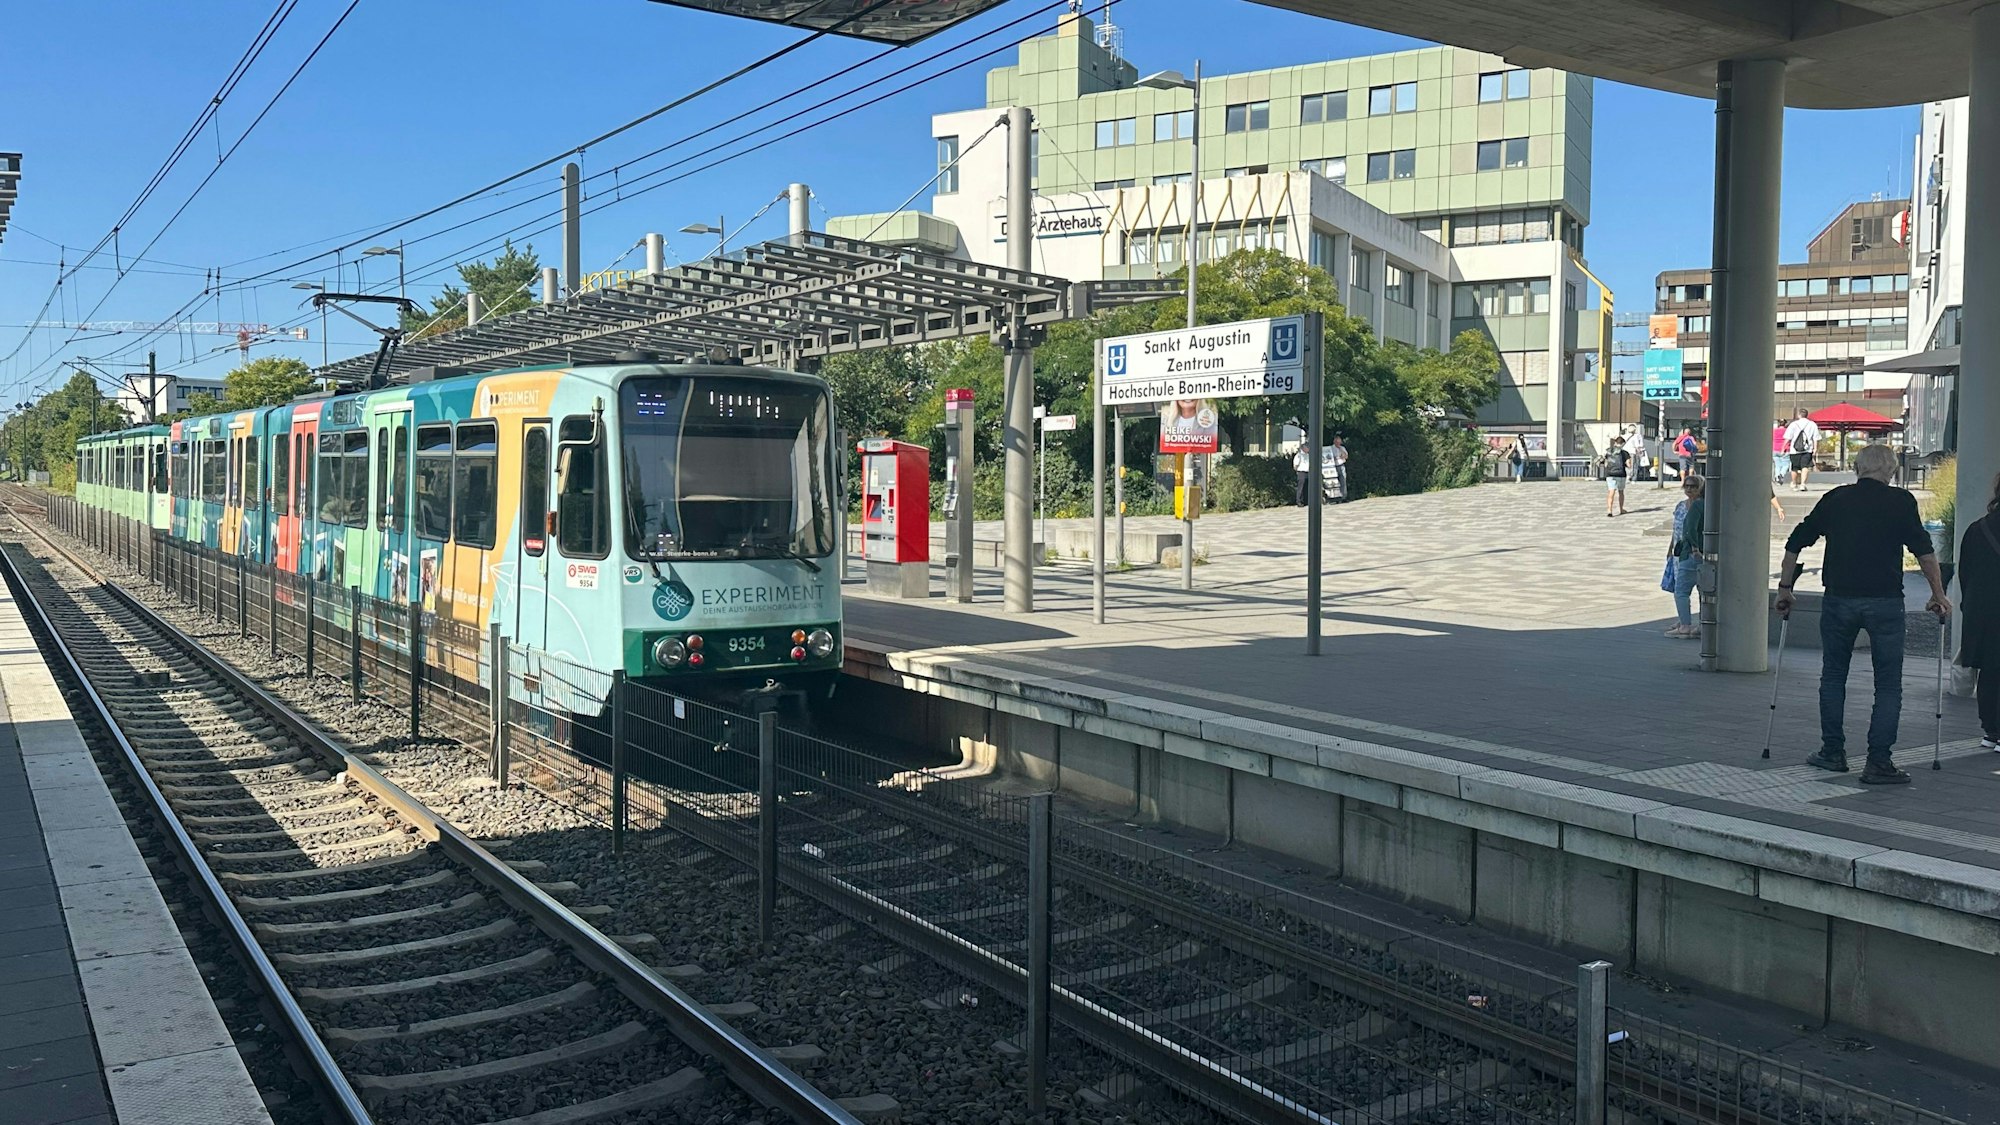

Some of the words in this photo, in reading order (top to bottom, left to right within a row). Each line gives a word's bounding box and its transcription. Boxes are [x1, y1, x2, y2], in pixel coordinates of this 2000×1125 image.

[1039, 215, 1102, 232] Ärztehaus
[1144, 337, 1181, 355] Sankt
[1189, 329, 1251, 352] Augustin
[1167, 357, 1224, 373] Zentrum
[1261, 352, 1269, 364] A
[1109, 381, 1174, 400] Hochschule
[1179, 372, 1294, 394] Bonn-Rhein-Sieg
[489, 390, 540, 407] PERIMENT
[1164, 434, 1212, 443] BOROWSKI
[577, 565, 597, 574] SWB
[580, 579, 593, 588] 9354
[702, 585, 824, 605] EXPERIMENT
[703, 606, 726, 615] DEINE
[729, 602, 823, 613] AUSTAUSCHORGANISATION
[728, 636, 765, 652] 9354
